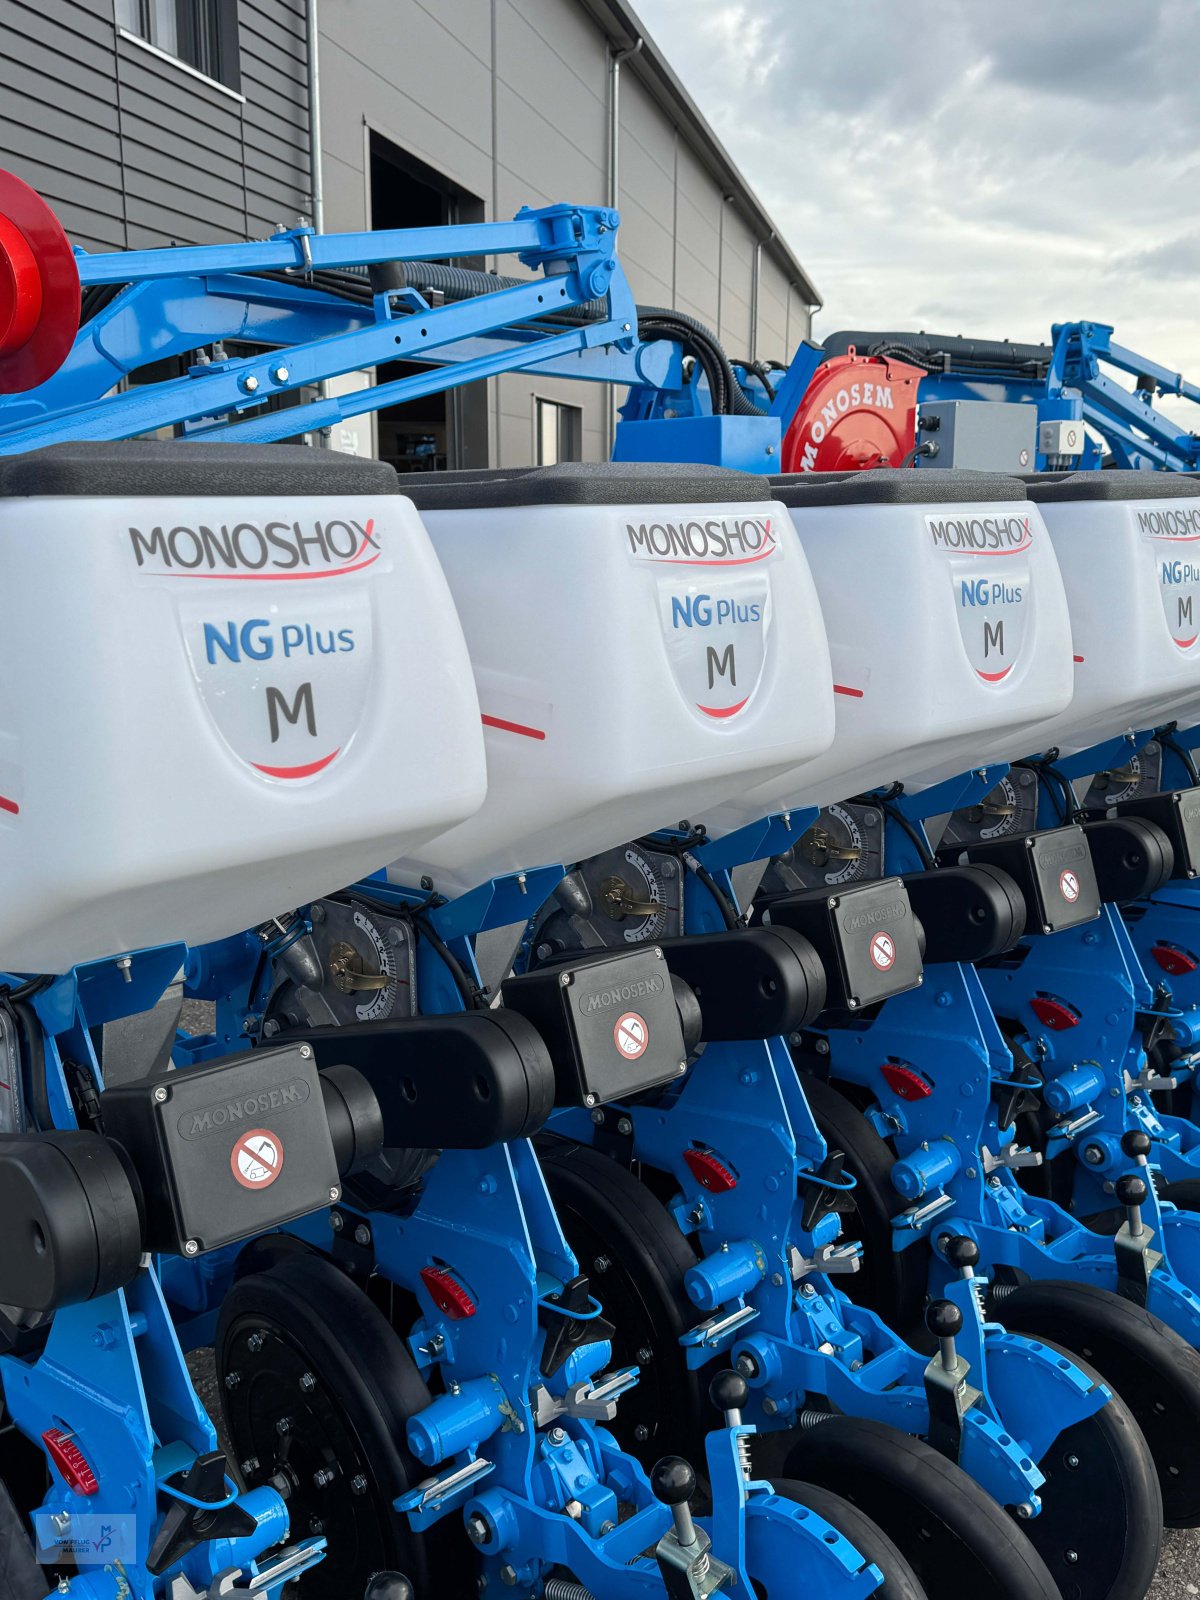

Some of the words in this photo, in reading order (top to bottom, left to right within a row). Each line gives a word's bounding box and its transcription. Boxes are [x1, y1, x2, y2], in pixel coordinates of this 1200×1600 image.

[800, 382, 894, 472] MONOSEM
[627, 519, 775, 557] MONOSHOX
[929, 516, 1032, 548] MONOSHOX
[1138, 509, 1200, 535] MONOSHO
[129, 518, 380, 569] MONOSHOX
[1162, 560, 1182, 584] NG
[672, 594, 713, 628] NG
[717, 599, 760, 624] Plus
[961, 579, 989, 606] NG
[992, 582, 1022, 604] Plus
[1178, 596, 1193, 628] M
[204, 619, 274, 664] NG
[282, 623, 354, 656] Plus
[984, 620, 1004, 657] M
[706, 644, 737, 689] M
[266, 682, 317, 743] M
[587, 978, 660, 1012] MONOSEM
[190, 1084, 303, 1135] MONOSEM
